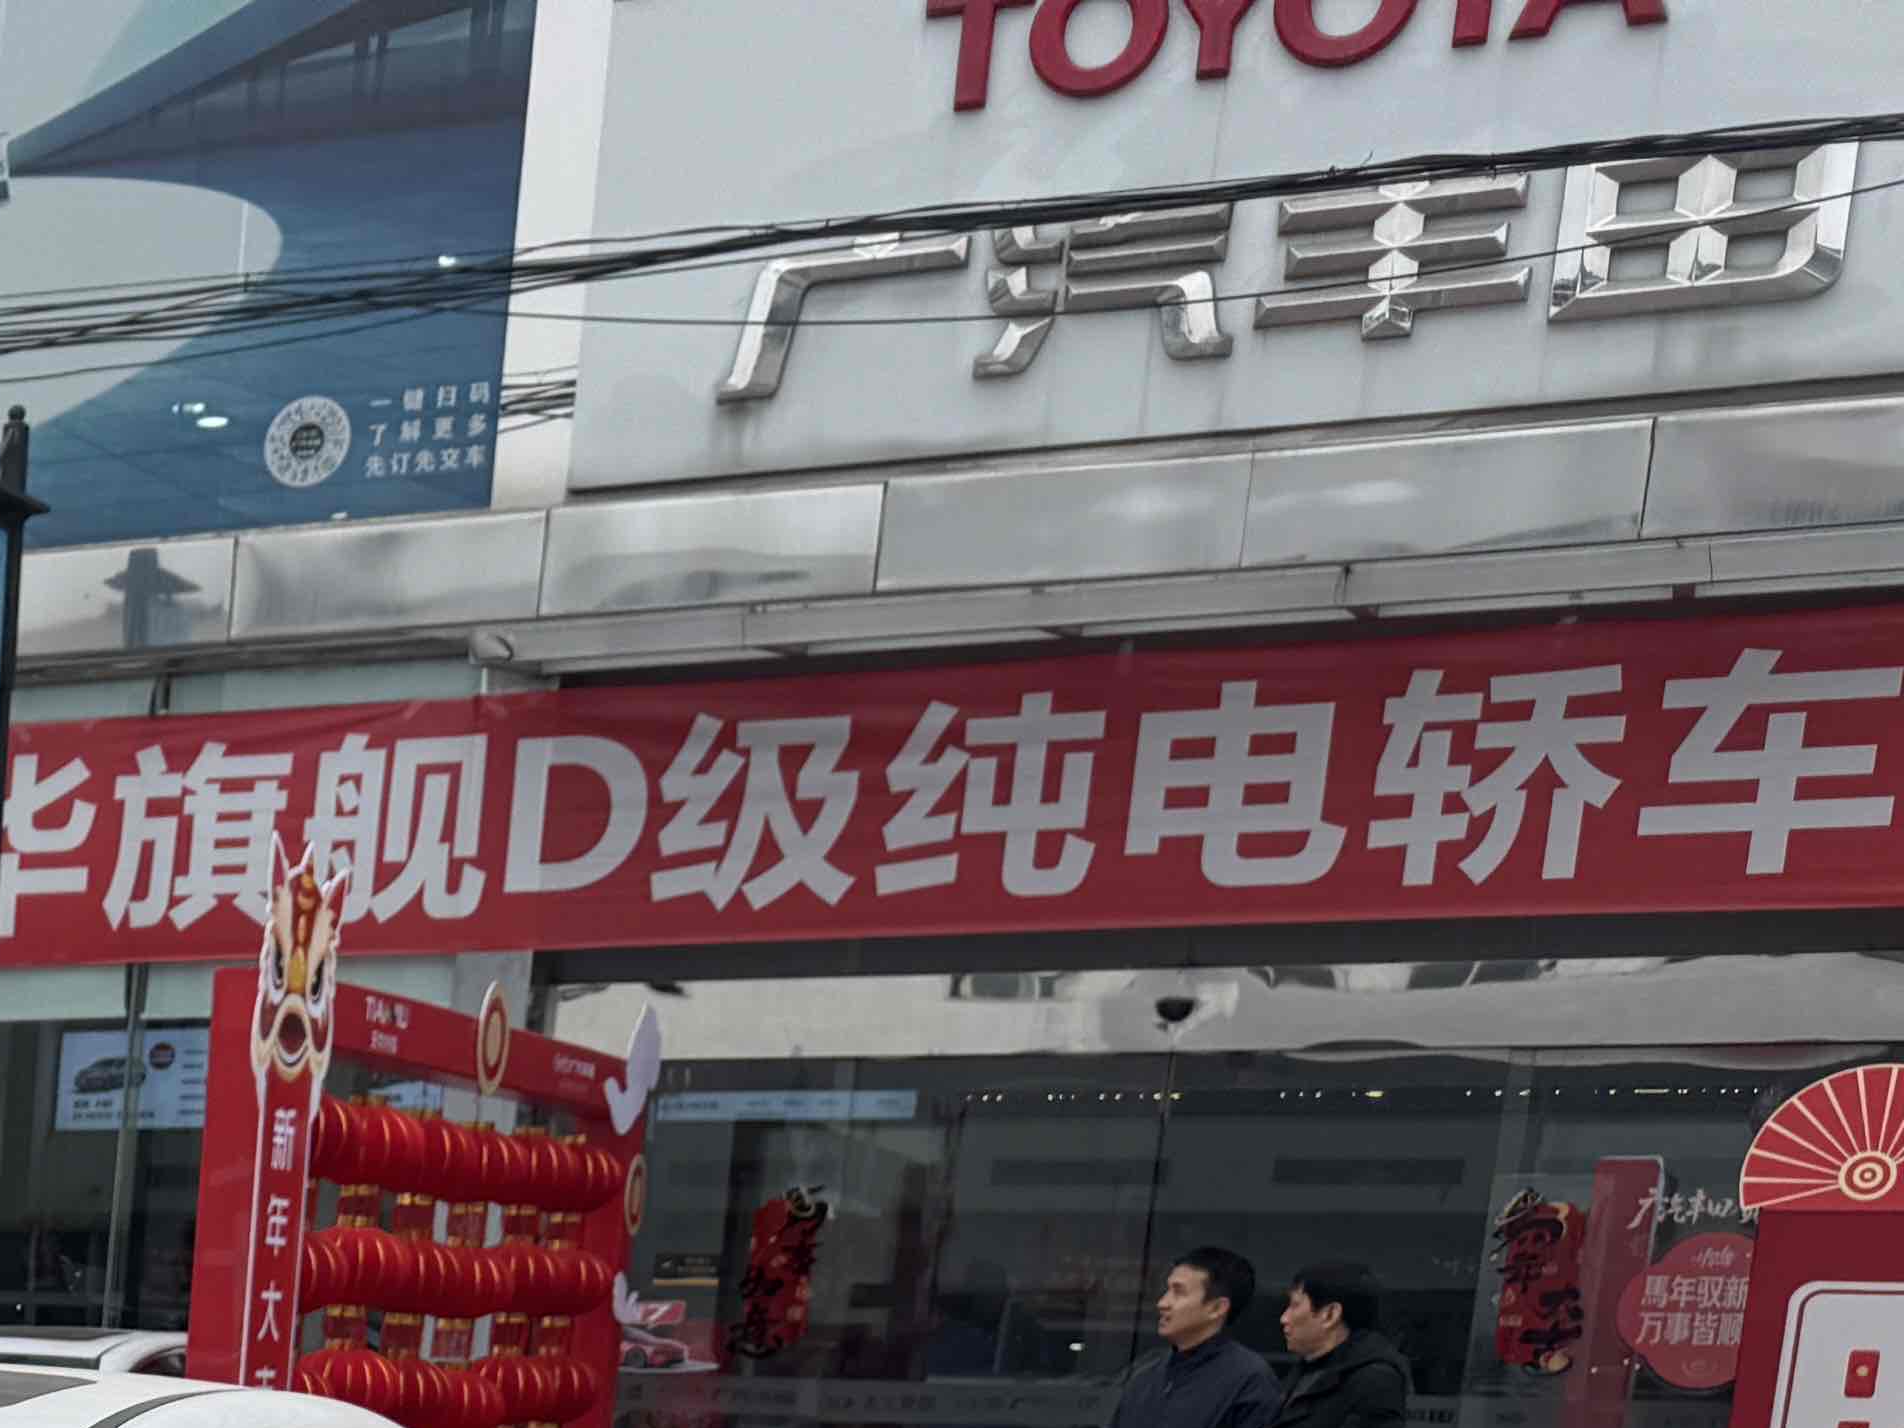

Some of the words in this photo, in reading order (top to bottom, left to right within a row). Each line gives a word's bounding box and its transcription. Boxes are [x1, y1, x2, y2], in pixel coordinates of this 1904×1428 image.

[925, 0, 1668, 111] TOYO
[716, 138, 1859, 404] 广汽丰田
[368, 413, 487, 447] 了解更多
